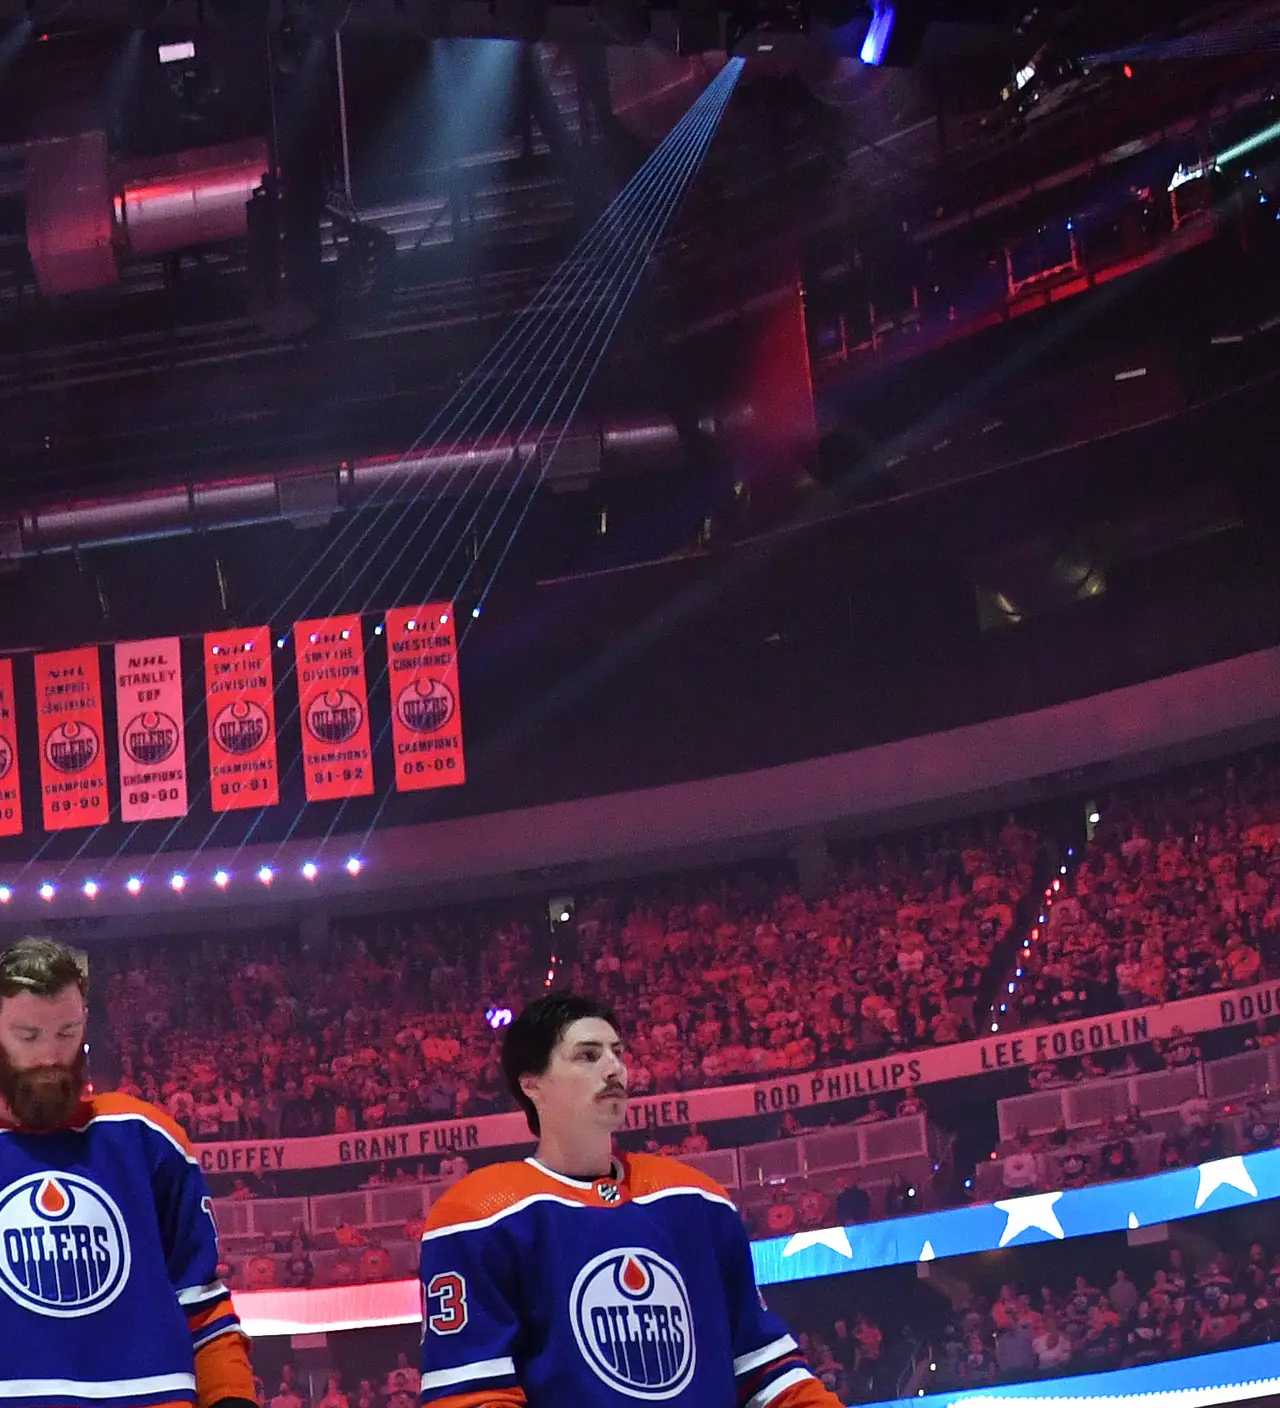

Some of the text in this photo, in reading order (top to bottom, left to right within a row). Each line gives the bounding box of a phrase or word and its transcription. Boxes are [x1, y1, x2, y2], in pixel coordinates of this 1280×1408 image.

[120, 668, 178, 689] STANLEY
[311, 706, 357, 730] OILERS
[402, 695, 448, 719] OILERS
[129, 728, 173, 751] OILERS
[219, 717, 264, 740] OILERS
[50, 737, 93, 761] OILERS
[1220, 979, 1280, 1023] DOU
[980, 1016, 1148, 1069] LEE FOGOLIN
[753, 1059, 921, 1113] ROD PHILLIPS
[621, 1100, 690, 1128] ATHER
[339, 1124, 479, 1162] GRANT FUHR
[201, 1146, 285, 1171] COFFEY
